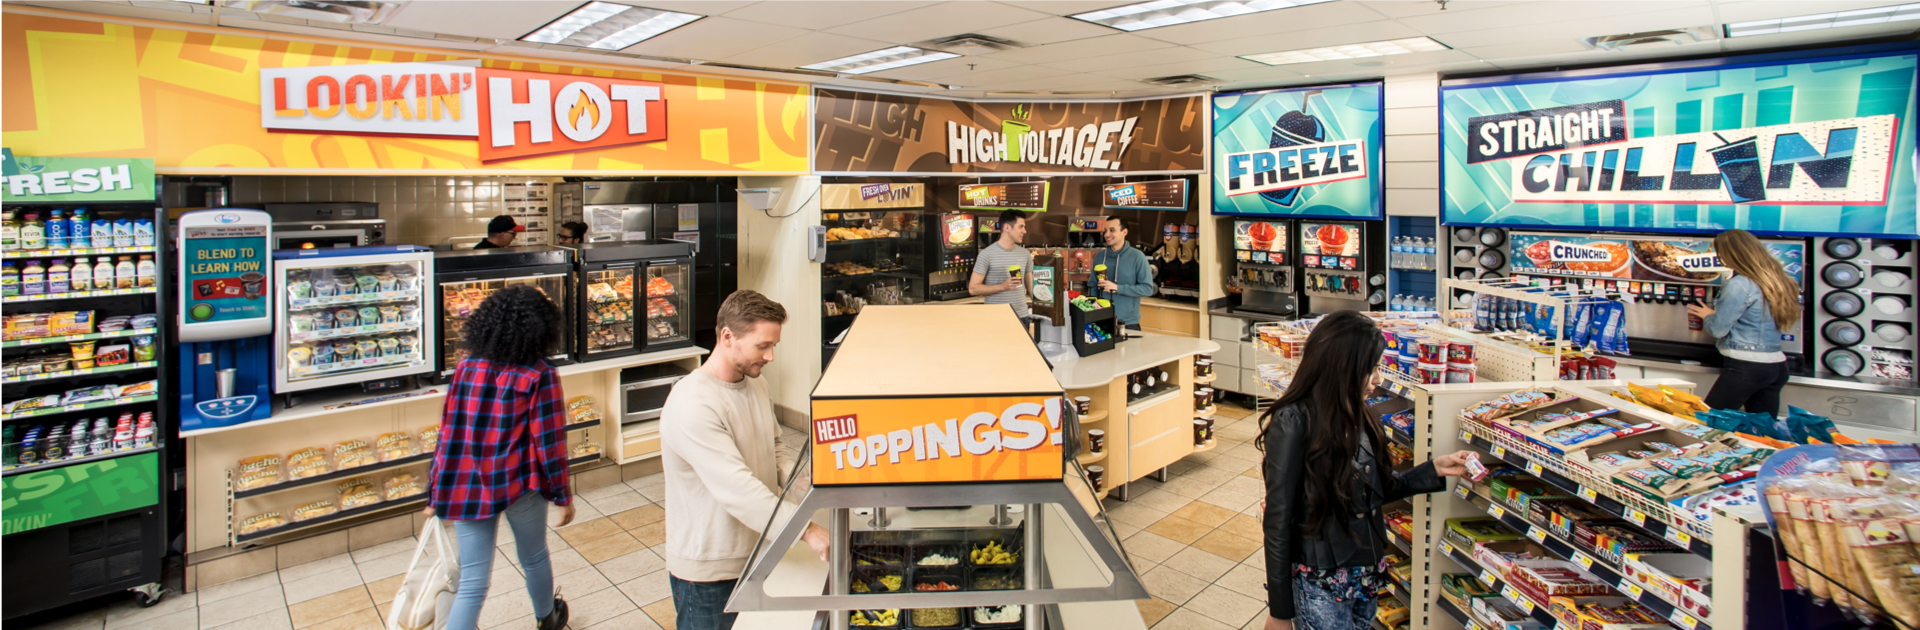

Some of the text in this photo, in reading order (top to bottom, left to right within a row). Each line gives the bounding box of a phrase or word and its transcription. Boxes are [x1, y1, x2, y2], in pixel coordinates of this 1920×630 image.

[273, 72, 661, 148] LOOKIN' HOT
[1479, 107, 1615, 156] STRAIGHT
[948, 116, 1139, 171] HIGH VOLTAGE!
[1228, 143, 1359, 190] FREEZE
[966, 188, 987, 198] HOT
[973, 195, 998, 206] DRINKS
[1110, 187, 1133, 198] ICED
[1117, 194, 1139, 206] COFFEE
[197, 247, 254, 260] BLEND TO
[1553, 245, 1607, 260] CRUNCHED
[191, 261, 260, 274] LEARN HOW
[1682, 256, 1721, 268] CUBE
[816, 417, 856, 442] HELLO
[830, 397, 1063, 470] TOPPINGS!
[1506, 496, 1524, 512] KIND
[1549, 521, 1570, 538] KIND
[1595, 545, 1619, 565] KIND
